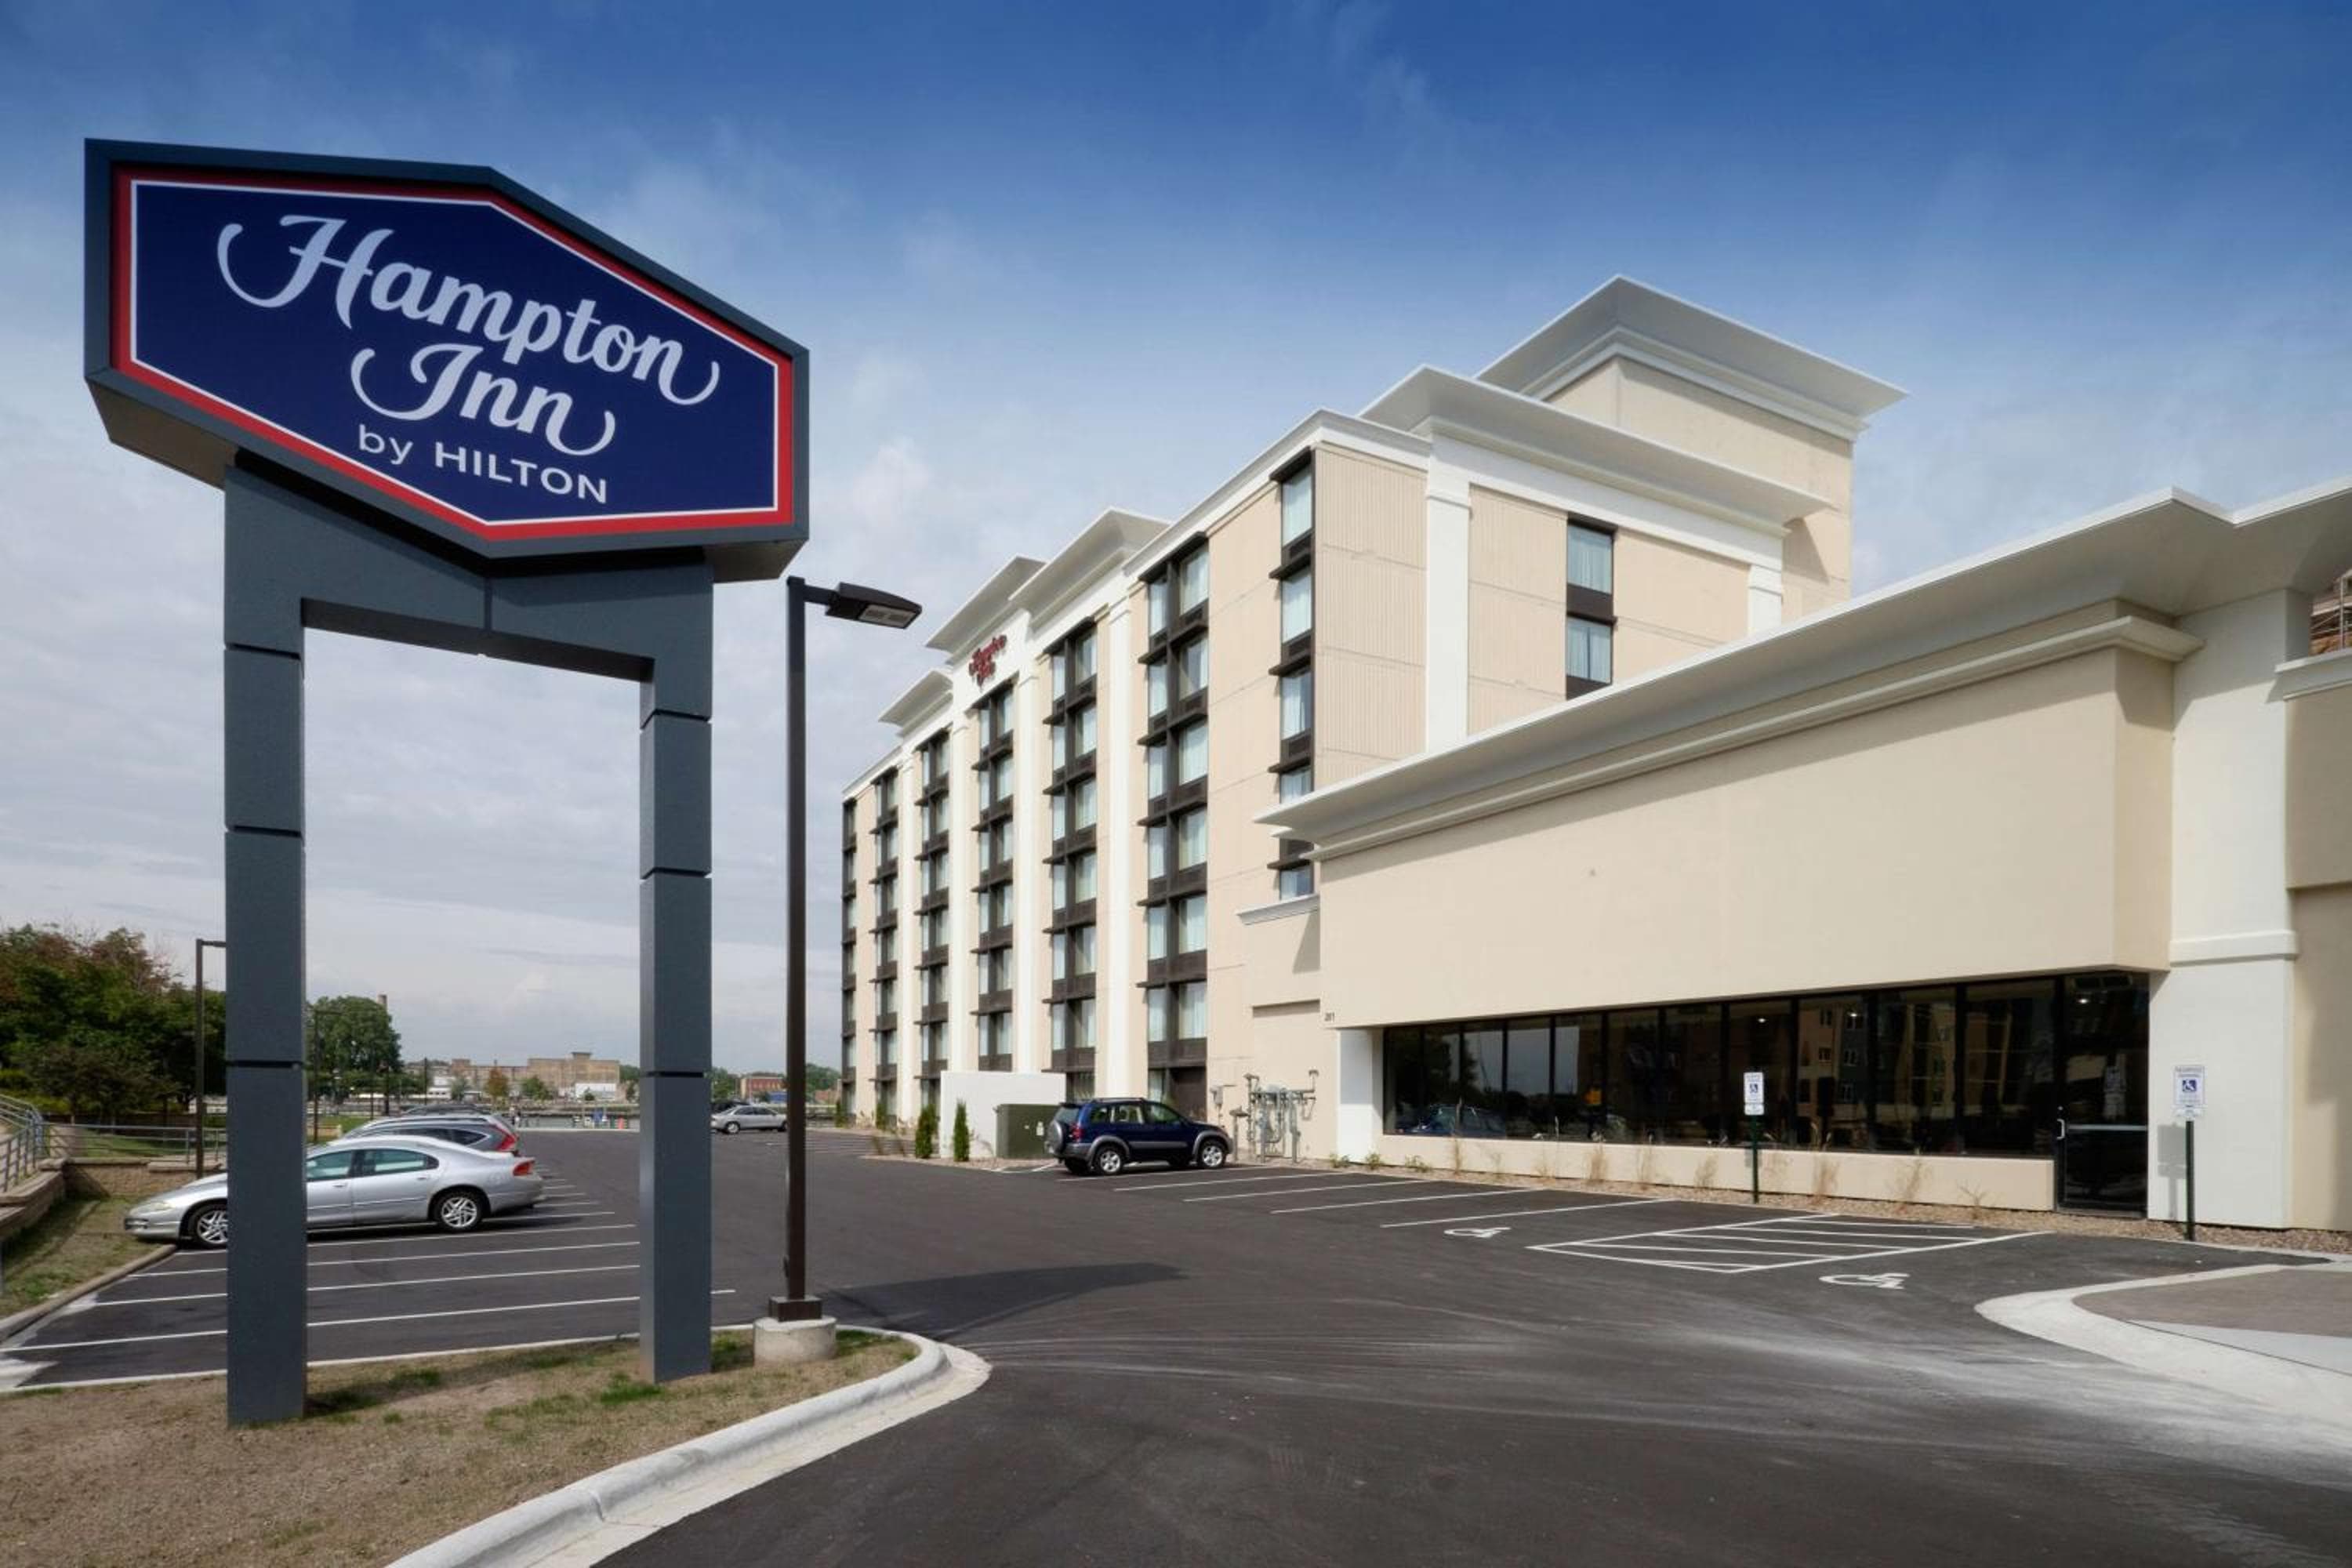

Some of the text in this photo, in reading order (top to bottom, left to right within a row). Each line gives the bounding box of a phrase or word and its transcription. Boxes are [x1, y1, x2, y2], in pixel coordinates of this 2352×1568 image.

[217, 215, 720, 405] Hampton
[350, 343, 615, 456] Inn
[358, 424, 607, 504] by HILTON
